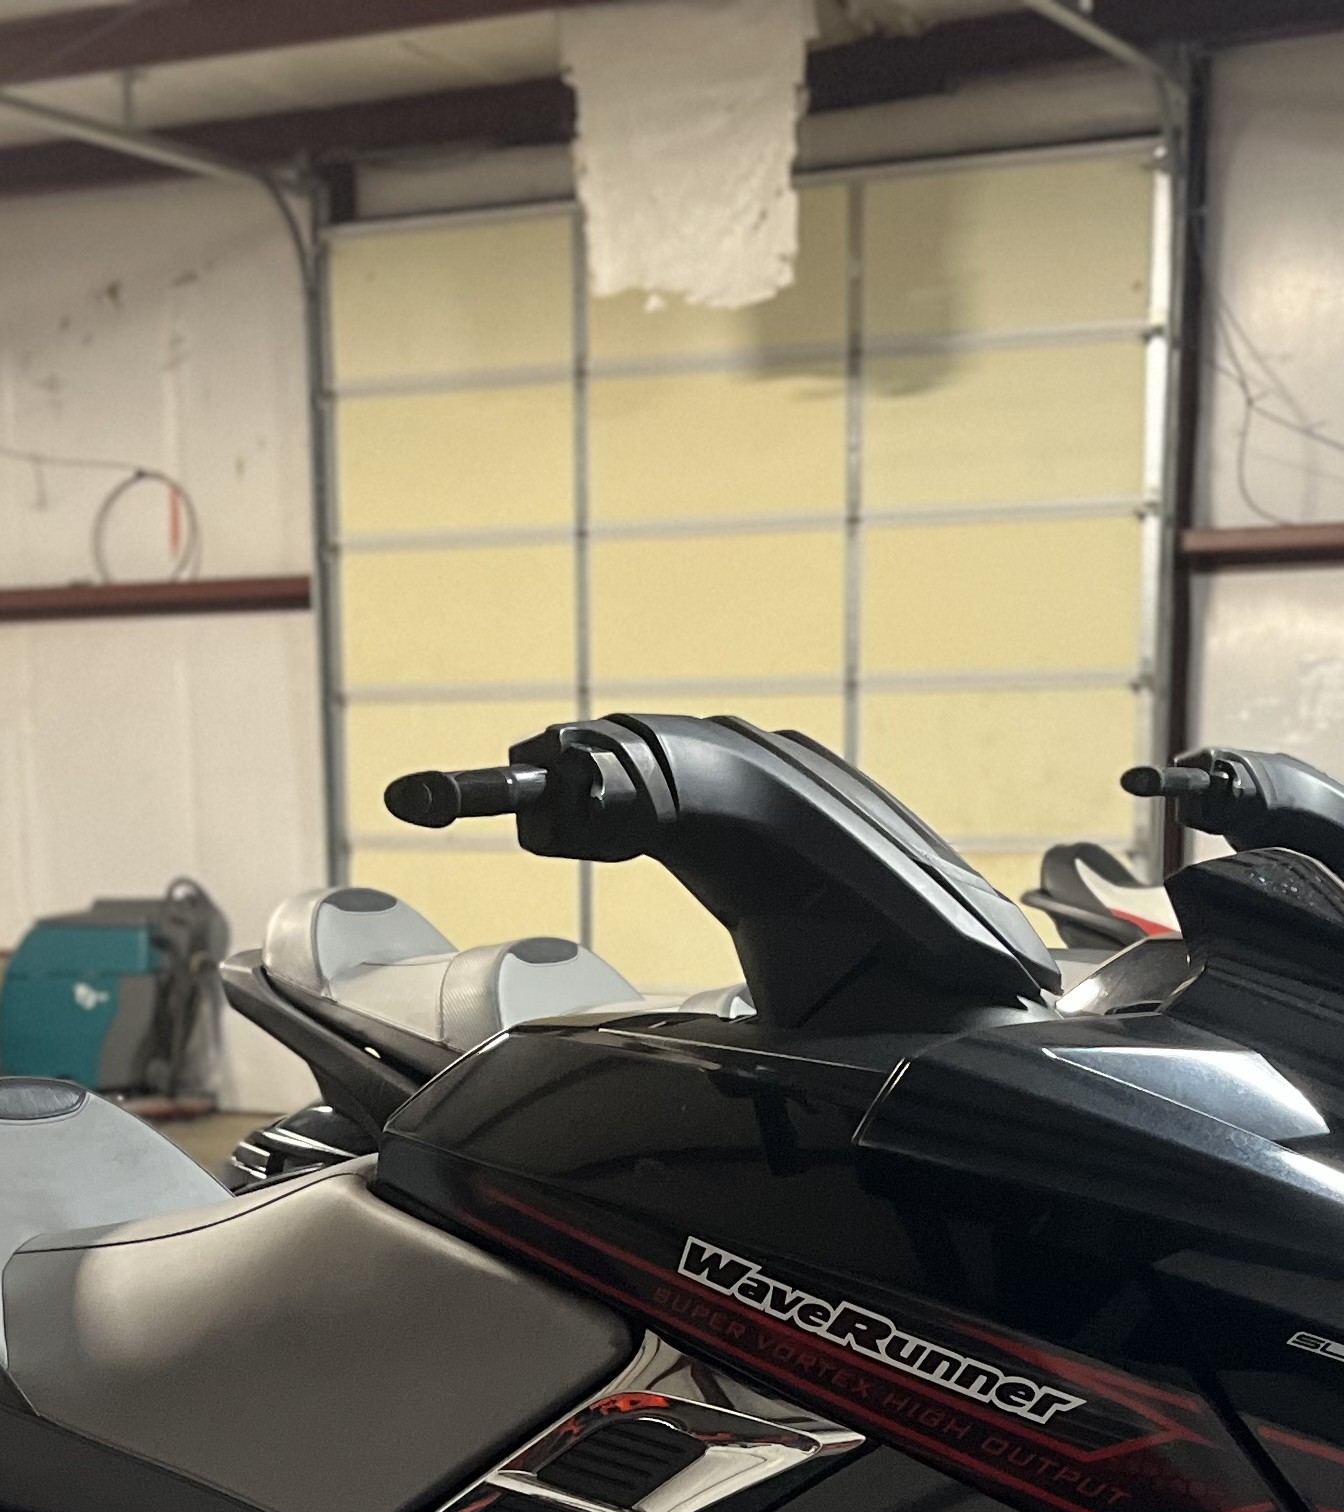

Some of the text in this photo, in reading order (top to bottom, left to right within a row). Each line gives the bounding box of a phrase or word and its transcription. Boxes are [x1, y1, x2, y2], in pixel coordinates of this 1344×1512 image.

[654, 1286, 1132, 1505] SUPER VORTEX HIGH OUTPUT
[677, 1236, 1087, 1424] WaveRunner
